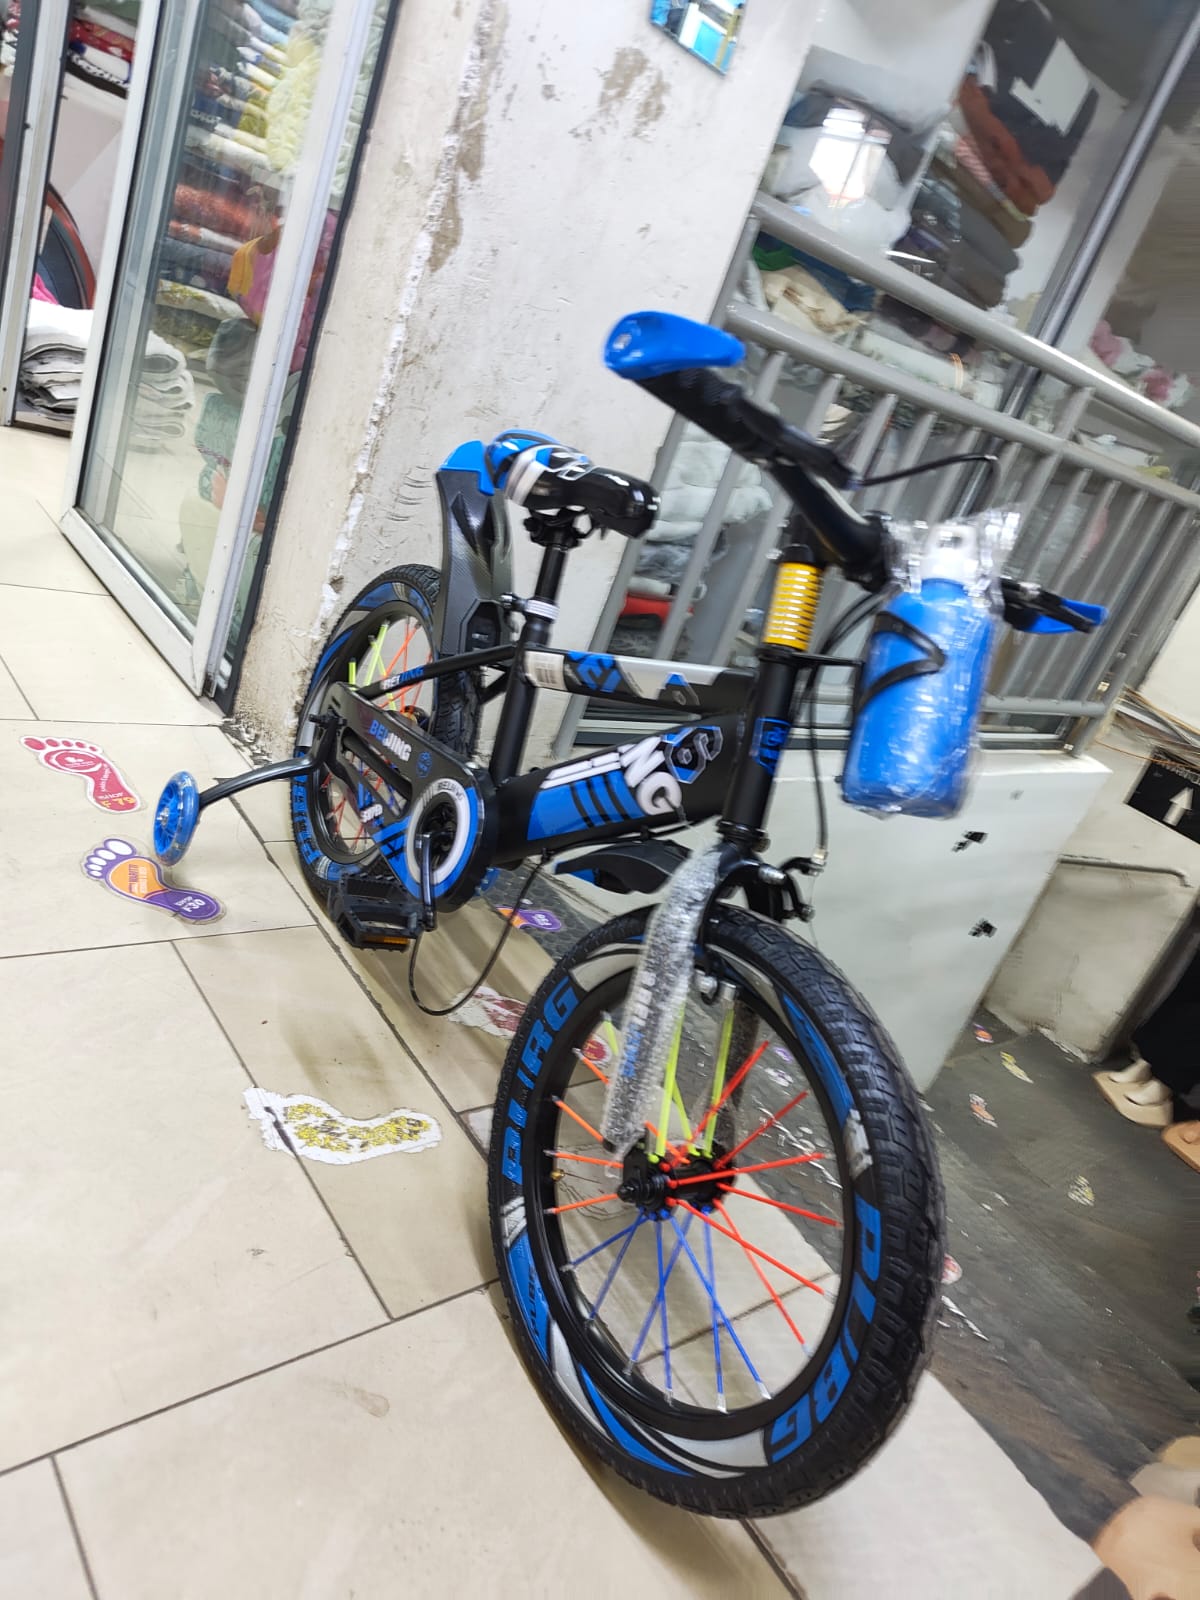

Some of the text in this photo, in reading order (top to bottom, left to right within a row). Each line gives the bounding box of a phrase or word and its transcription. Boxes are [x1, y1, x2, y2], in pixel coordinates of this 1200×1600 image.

[369, 720, 412, 761] BEIJING
[182, 898, 207, 914] F30
[768, 1193, 884, 1464] PUBG
